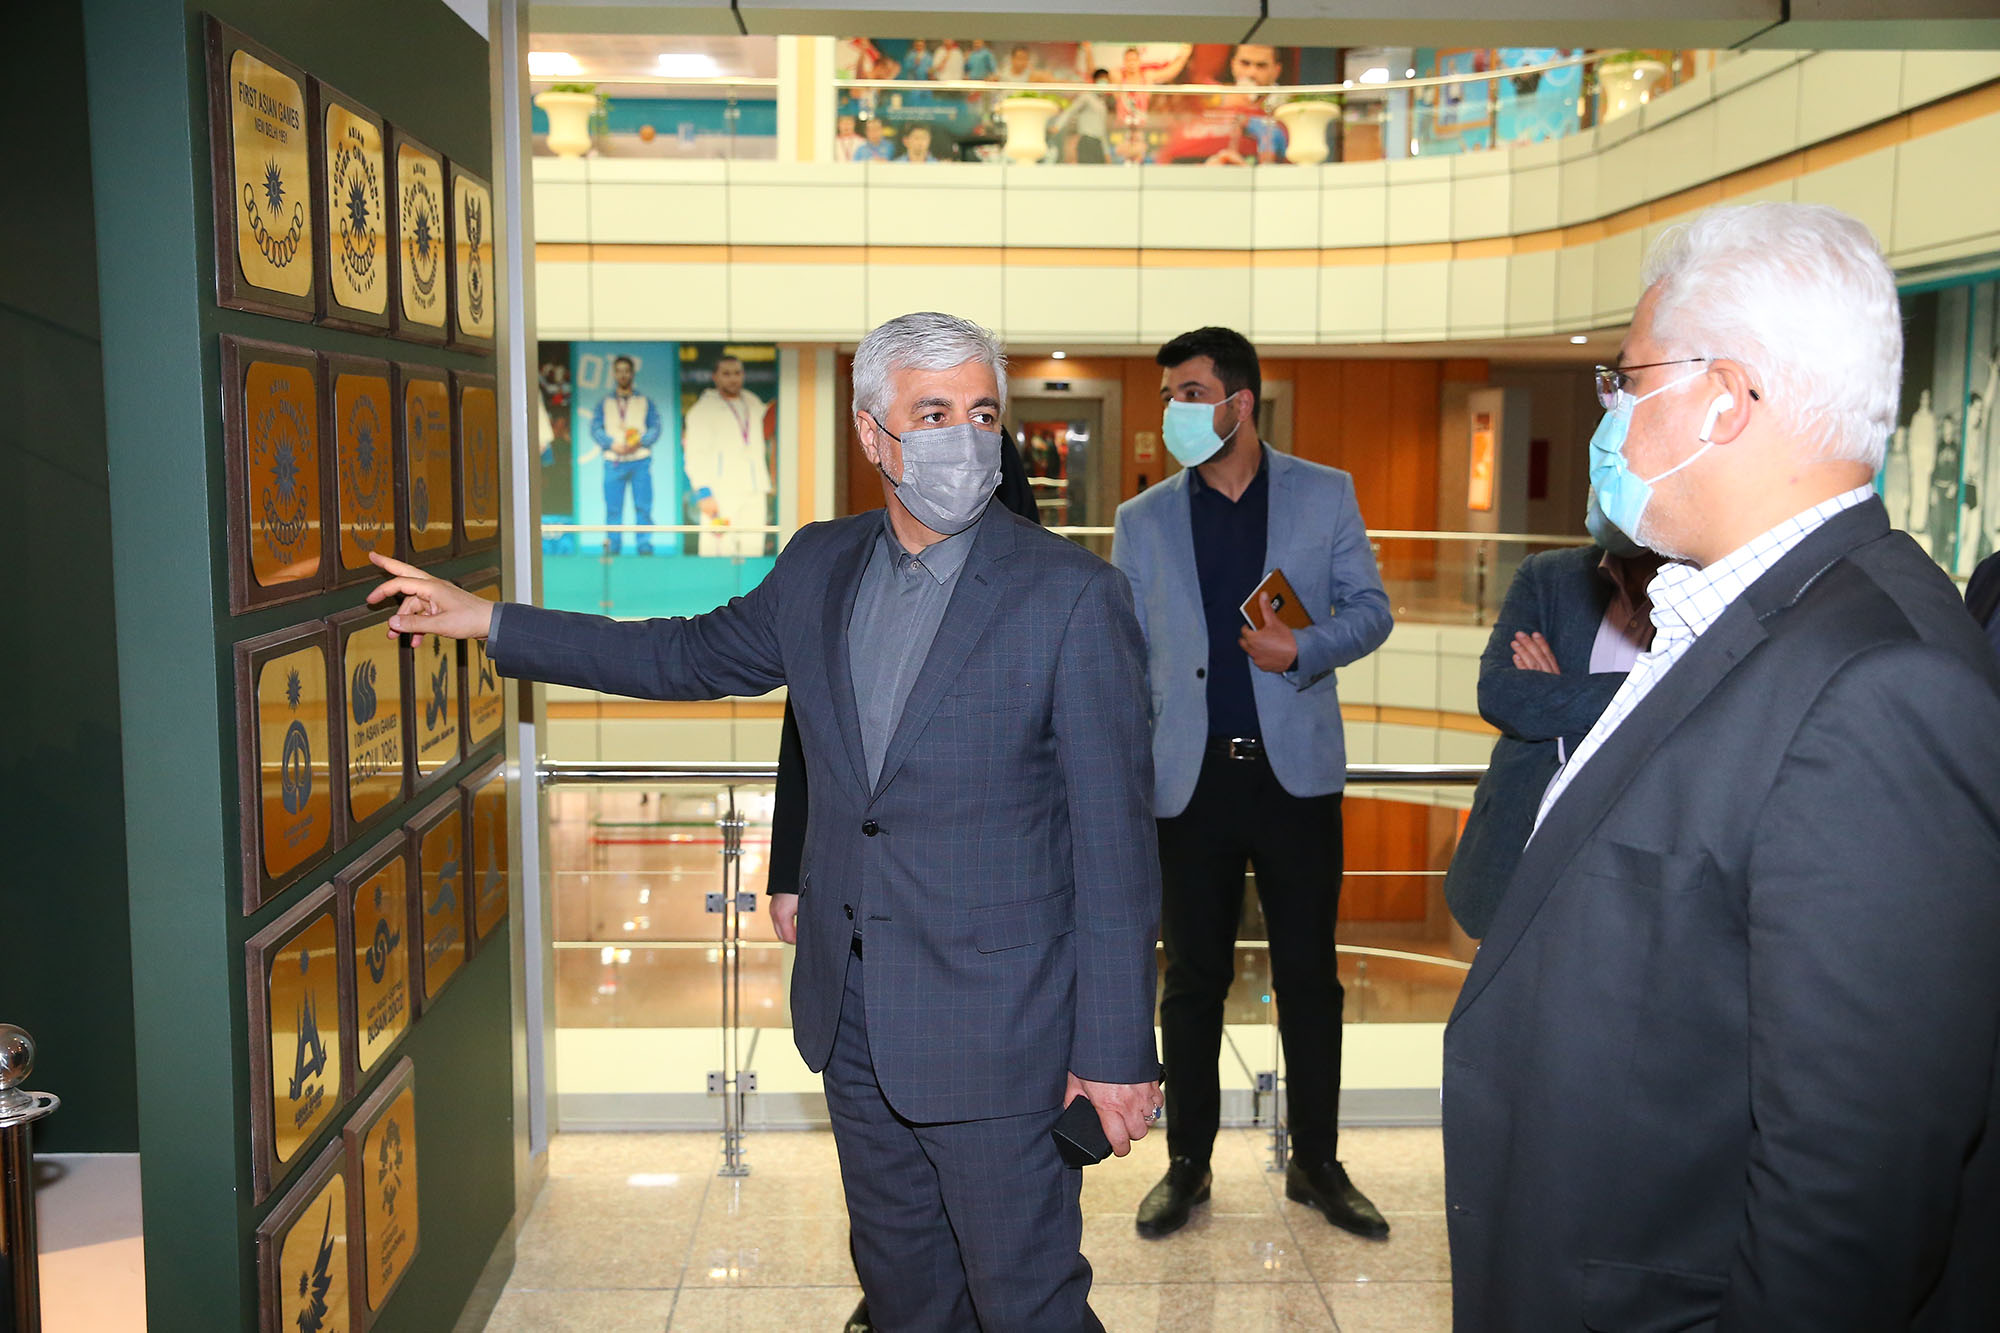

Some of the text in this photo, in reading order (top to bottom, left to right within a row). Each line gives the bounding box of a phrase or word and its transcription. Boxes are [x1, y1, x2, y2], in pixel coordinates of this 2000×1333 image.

[239, 81, 300, 130] FIRST ASIAN GAMES
[255, 117, 265, 134] NEW
[265, 122, 278, 139] DELHI
[339, 149, 351, 188] EVER
[366, 724, 380, 742] ASIAN
[381, 714, 397, 734] GAMES
[355, 747, 382, 784] SEOUL
[381, 736, 398, 768] 1986
